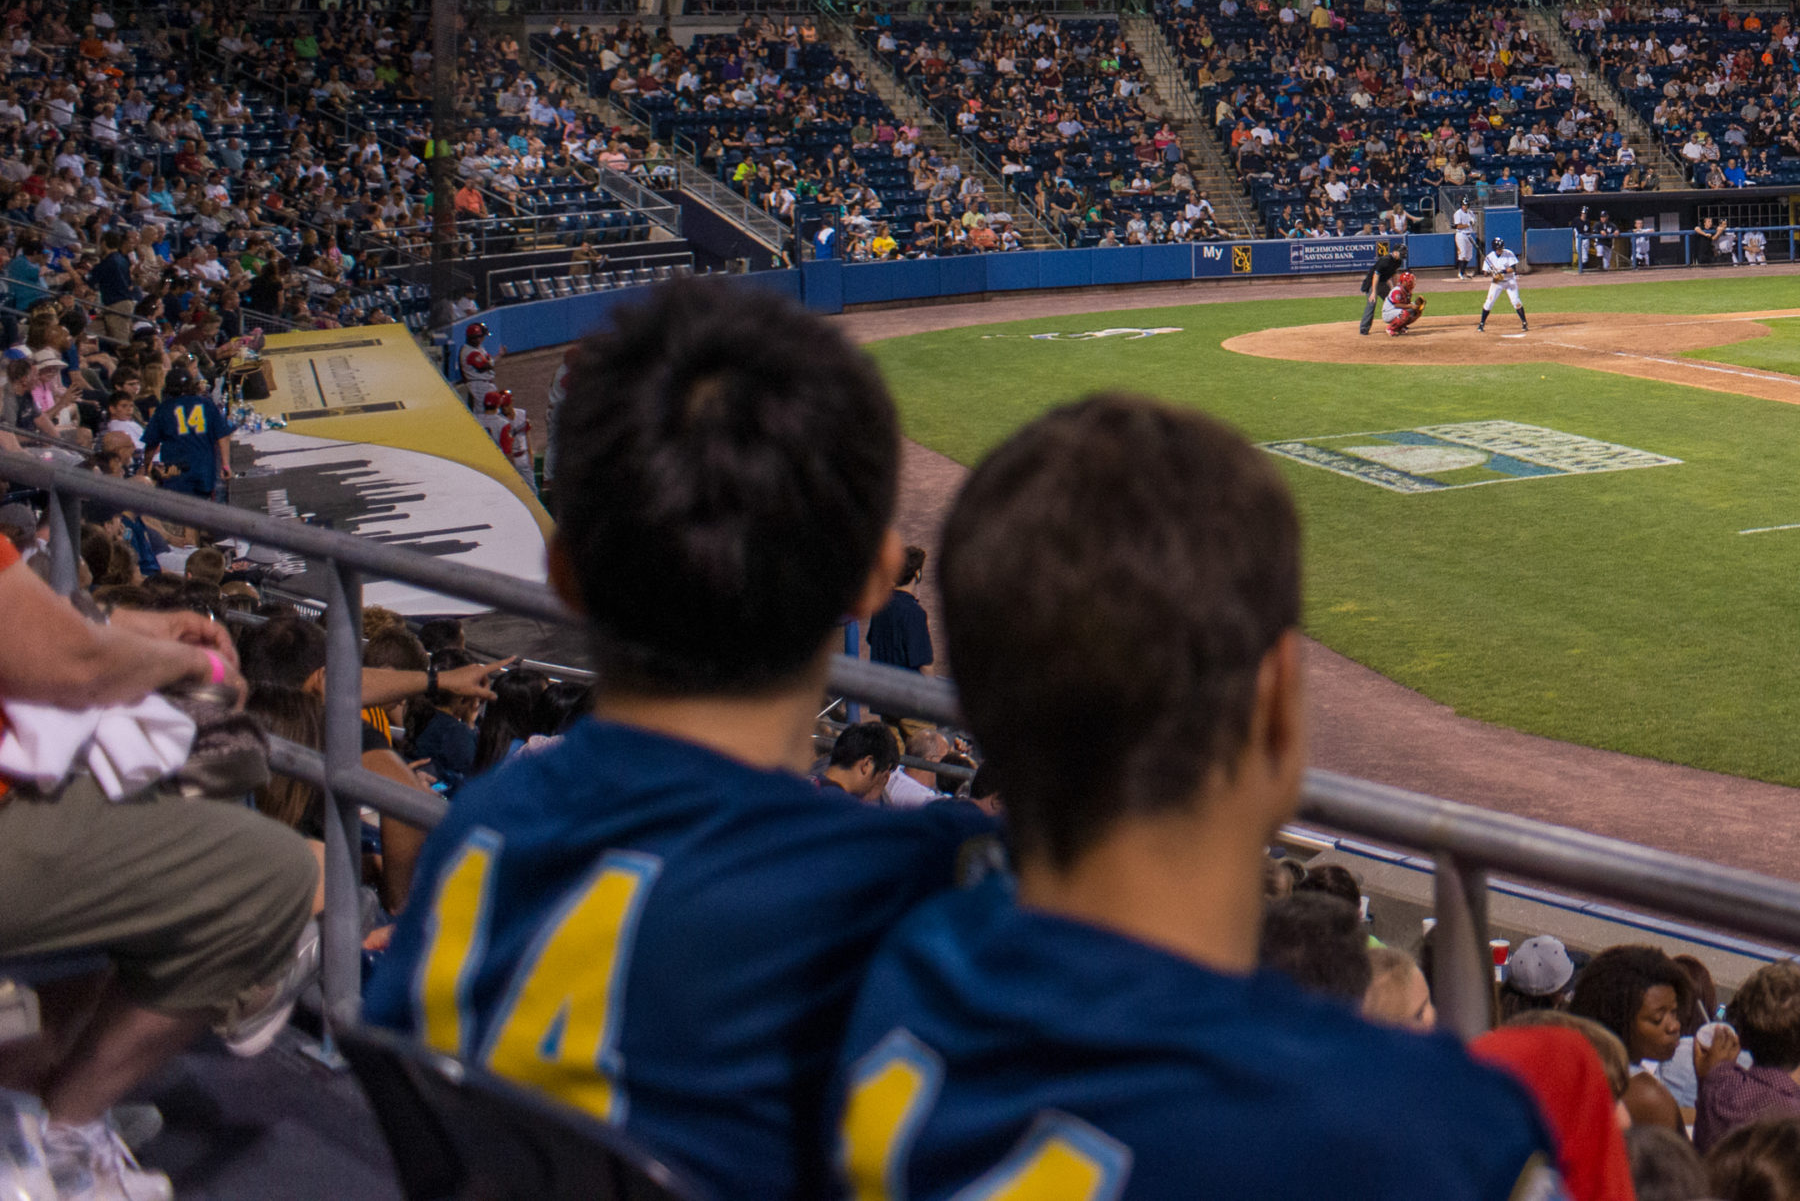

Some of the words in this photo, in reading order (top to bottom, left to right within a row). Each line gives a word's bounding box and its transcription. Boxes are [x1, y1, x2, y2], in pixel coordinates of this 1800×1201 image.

[1203, 246, 1224, 260] My
[1304, 245, 1344, 254] RICHMOND
[1344, 244, 1375, 252] COUNTY
[1304, 253, 1334, 261] SAVINGS
[1334, 252, 1354, 260] BANK
[173, 404, 207, 435] 14
[412, 826, 664, 1130] 14
